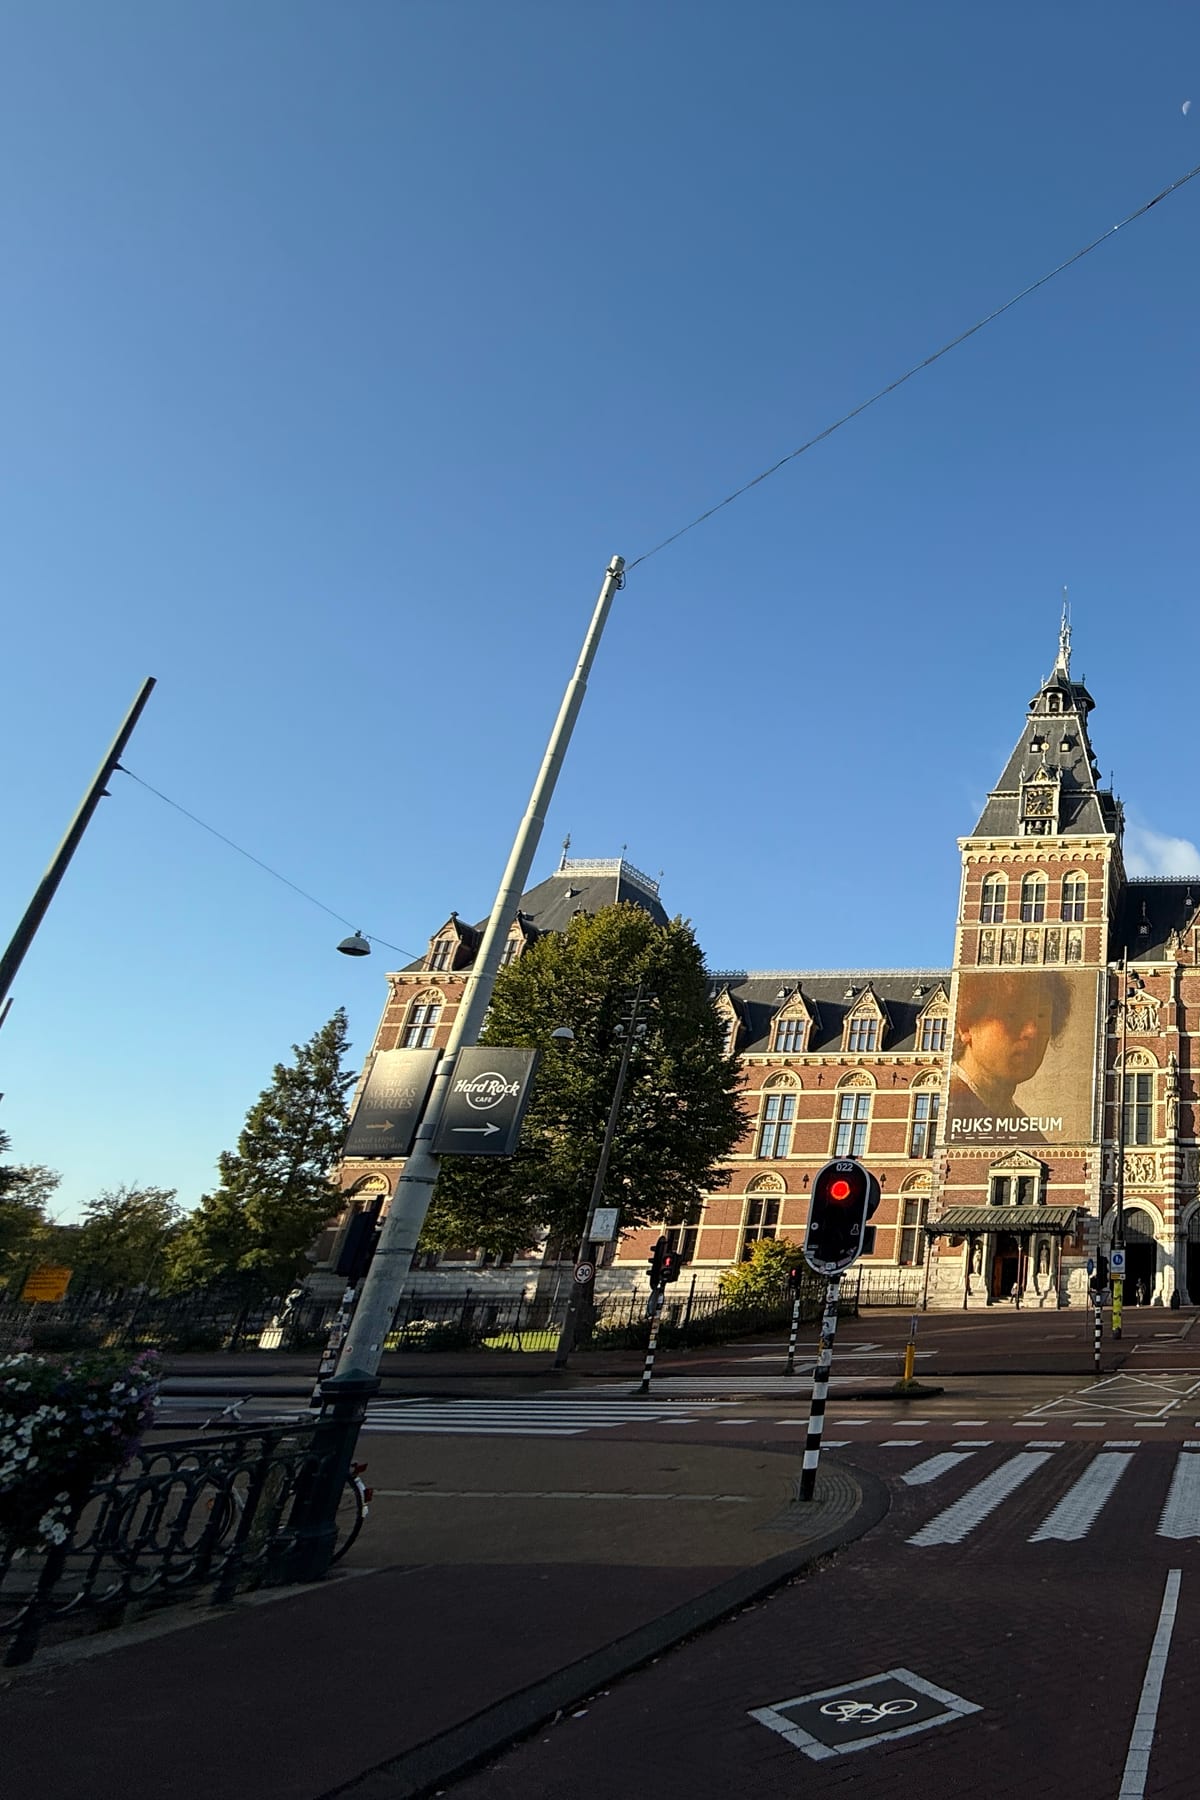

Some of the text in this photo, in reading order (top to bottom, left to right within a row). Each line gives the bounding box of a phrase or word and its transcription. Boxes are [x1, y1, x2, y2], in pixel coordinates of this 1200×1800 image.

[454, 1080, 520, 1096] Hard Rock
[364, 1098, 414, 1109] DIARIES
[951, 1117, 1062, 1133] RIJKS MUSEUM
[836, 1163, 854, 1172] 022
[578, 1268, 590, 1277] 30
